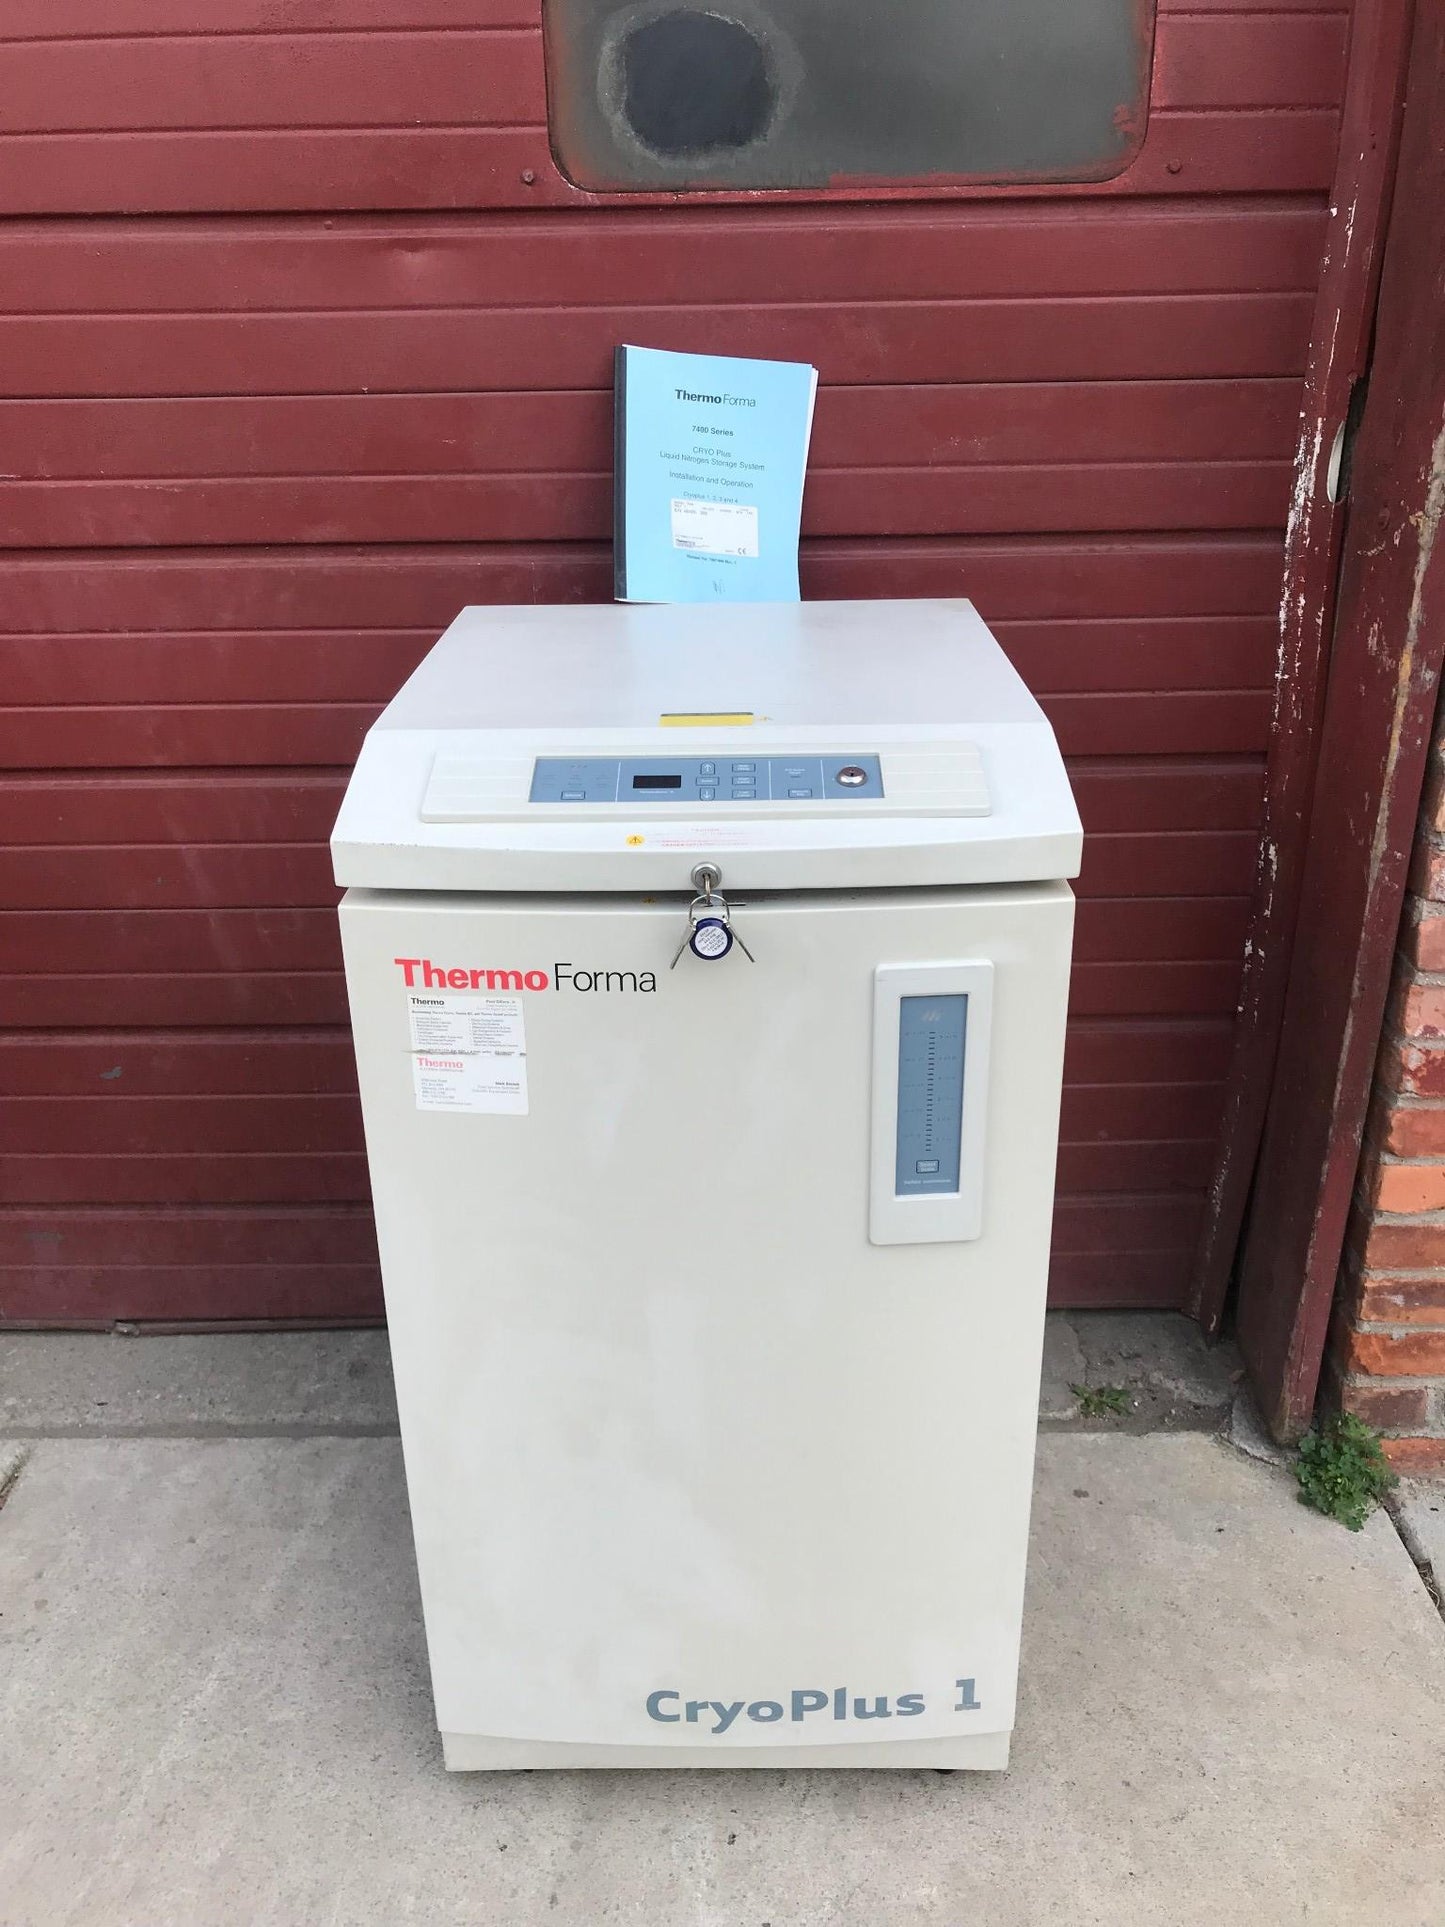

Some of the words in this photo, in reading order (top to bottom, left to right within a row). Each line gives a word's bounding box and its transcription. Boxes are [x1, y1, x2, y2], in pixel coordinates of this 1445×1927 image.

[675, 388, 722, 404] Thermo
[723, 393, 756, 407] Forma
[710, 427, 735, 437] Series
[659, 451, 680, 461] Liquid
[681, 454, 710, 465] Nitrogen
[711, 458, 738, 469] Storage
[739, 461, 765, 472] System
[692, 446, 715, 456] CRYO
[716, 449, 732, 458] Plus
[669, 470, 705, 482] Installation
[720, 478, 754, 489] Operation
[393, 957, 550, 992] Thermo
[554, 962, 657, 993] Forma
[410, 997, 445, 1006] Thermo
[416, 1057, 464, 1069] Thermo
[646, 1687, 926, 1734] CryoPlus
[954, 1678, 982, 1711] 1
